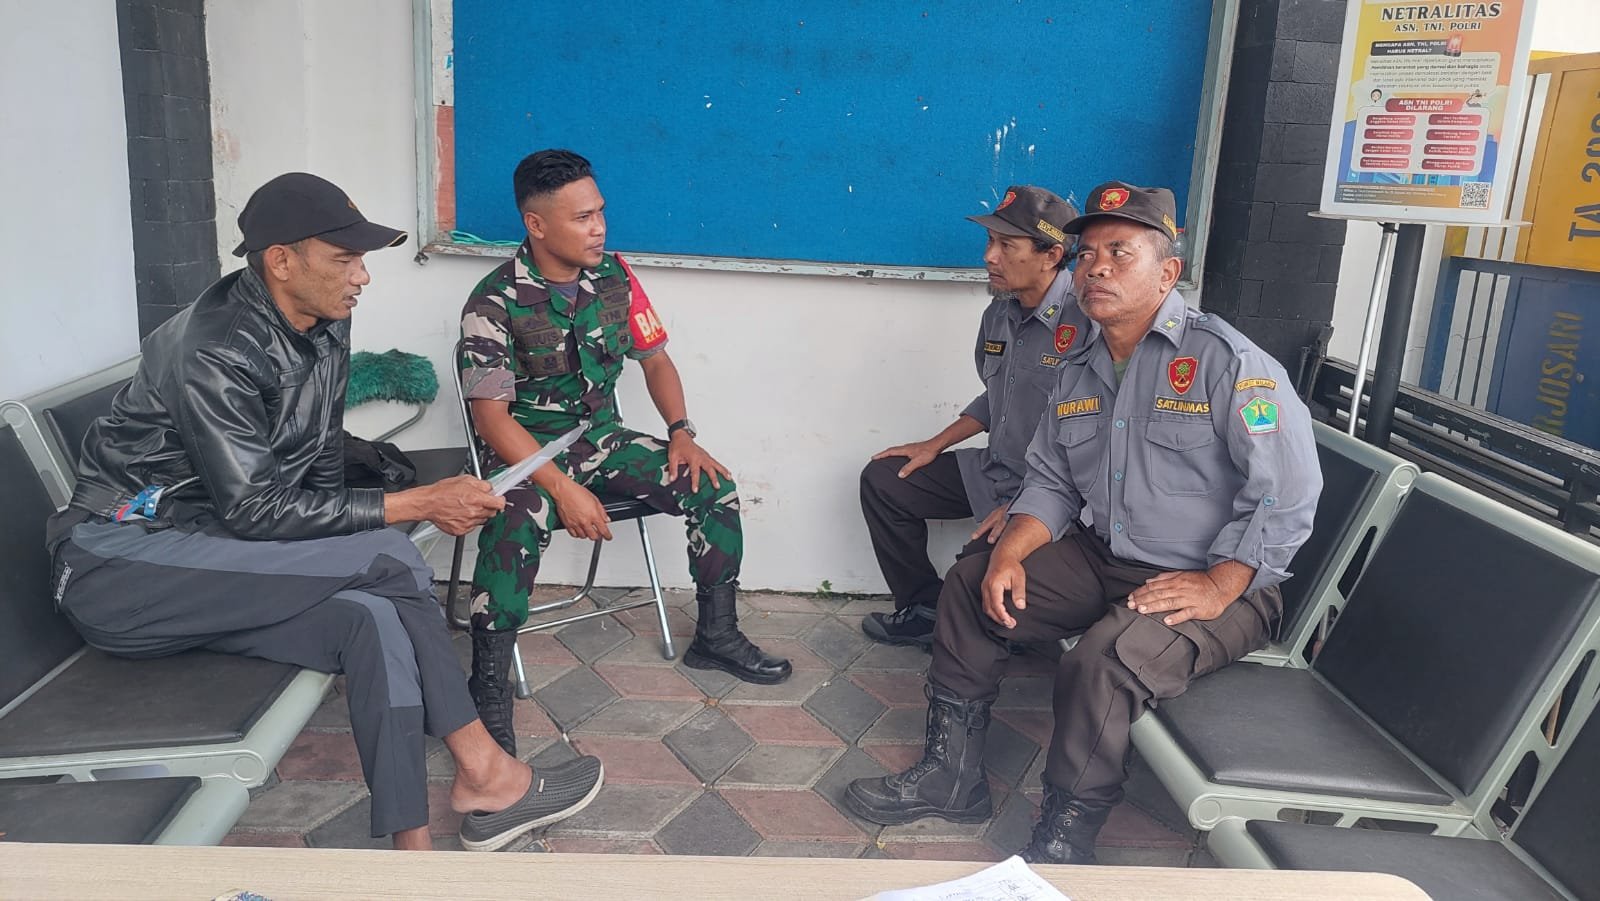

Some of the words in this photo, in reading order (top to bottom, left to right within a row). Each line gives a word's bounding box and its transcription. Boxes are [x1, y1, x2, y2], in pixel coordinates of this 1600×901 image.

[1382, 4, 1501, 20] NETRALITAS
[1450, 22, 1481, 30] POLRI
[1156, 399, 1210, 413] SATLINMAS
